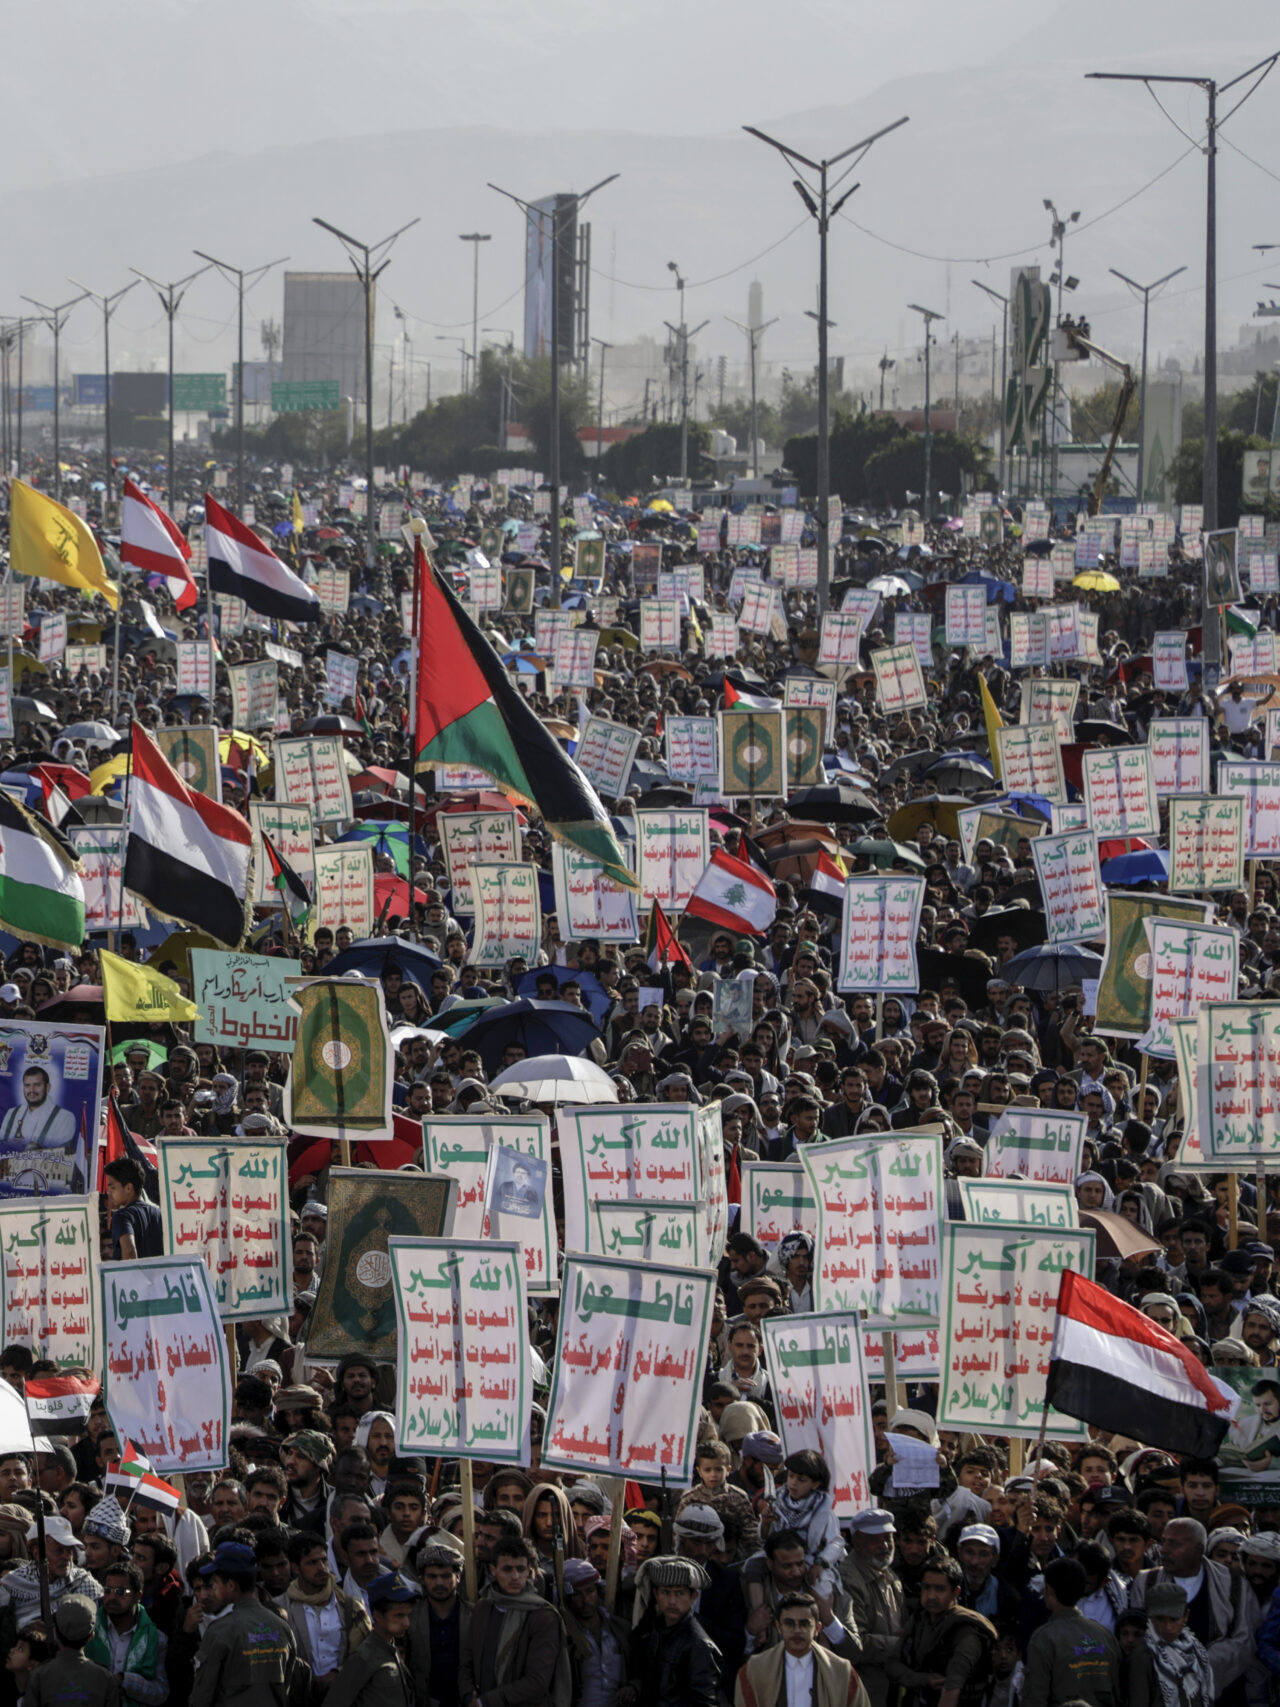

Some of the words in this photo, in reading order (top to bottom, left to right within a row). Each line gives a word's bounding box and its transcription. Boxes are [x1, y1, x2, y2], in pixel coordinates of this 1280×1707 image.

[232, 968, 262, 1002] أمريكا
[220, 1007, 298, 1046] الخطوط
[1216, 1009, 1271, 1040] أكبر
[585, 1117, 647, 1158] أكبر
[651, 1123, 689, 1149] الله
[1216, 1123, 1264, 1148] للإسلام
[172, 1148, 233, 1188] أكبر
[239, 1153, 278, 1179] الله
[588, 1161, 641, 1184] لأمريكا
[647, 1162, 690, 1183] الموت
[819, 1142, 883, 1184] أكبر
[889, 1145, 933, 1176] الله
[174, 1187, 226, 1214] لأمريكا
[232, 1193, 277, 1213] الموت
[824, 1186, 878, 1217] لأمريكا
[884, 1192, 933, 1215] الموت
[6, 1218, 51, 1256] أكبر
[56, 1222, 85, 1245] الله
[176, 1222, 227, 1245] لإسرائيل
[233, 1221, 277, 1242] الموت
[606, 1211, 656, 1255] أكبر
[659, 1219, 692, 1248] الله
[825, 1224, 881, 1250] لإسرائيل
[887, 1225, 935, 1250] الموت
[7, 1255, 46, 1280] لأمريكا
[51, 1258, 86, 1279] الموت
[217, 1252, 238, 1274] على
[244, 1248, 278, 1268] اللعنة
[822, 1258, 865, 1283] اليهود
[872, 1259, 893, 1283] على
[899, 1256, 936, 1279] اللعنة
[957, 1237, 1036, 1280] أكبر
[1038, 1244, 1085, 1274] الله
[405, 1253, 464, 1298] أكبر
[470, 1259, 513, 1291] الله
[8, 1290, 47, 1310] لإسرائيل
[51, 1288, 88, 1309] الموت
[111, 1271, 203, 1331] قاطعوا
[231, 1276, 279, 1309] النصر
[576, 1268, 696, 1326] قاطعوا
[889, 1288, 940, 1322] النصر
[957, 1282, 1023, 1309] لأمريكا
[6, 1318, 34, 1339] اليهود
[38, 1316, 58, 1339] على
[63, 1314, 89, 1334] اللعنة
[407, 1301, 458, 1331] لأمريكا
[465, 1307, 514, 1331] الموت
[955, 1317, 1020, 1346] لإسرائيل
[109, 1330, 161, 1384] الأمريكية
[166, 1330, 217, 1376] البضائع
[411, 1338, 460, 1364] لإسرائيل
[466, 1341, 516, 1367] الموت
[562, 1332, 629, 1376] الأمريكية
[633, 1337, 695, 1384] البضائع
[772, 1323, 851, 1380] قاطعوا
[158, 1380, 166, 1412] و
[410, 1376, 447, 1400] اليهود
[452, 1378, 473, 1403] على
[480, 1375, 515, 1400] اللعنة
[614, 1382, 624, 1414] و
[34, 1400, 64, 1414] قلوبنا
[67, 1398, 82, 1414] في
[779, 1379, 819, 1429] الأمريكية
[821, 1383, 860, 1425] البضائع
[950, 1384, 1014, 1419] للإسلام
[408, 1408, 461, 1448] للإسلام
[466, 1409, 514, 1447] النصر
